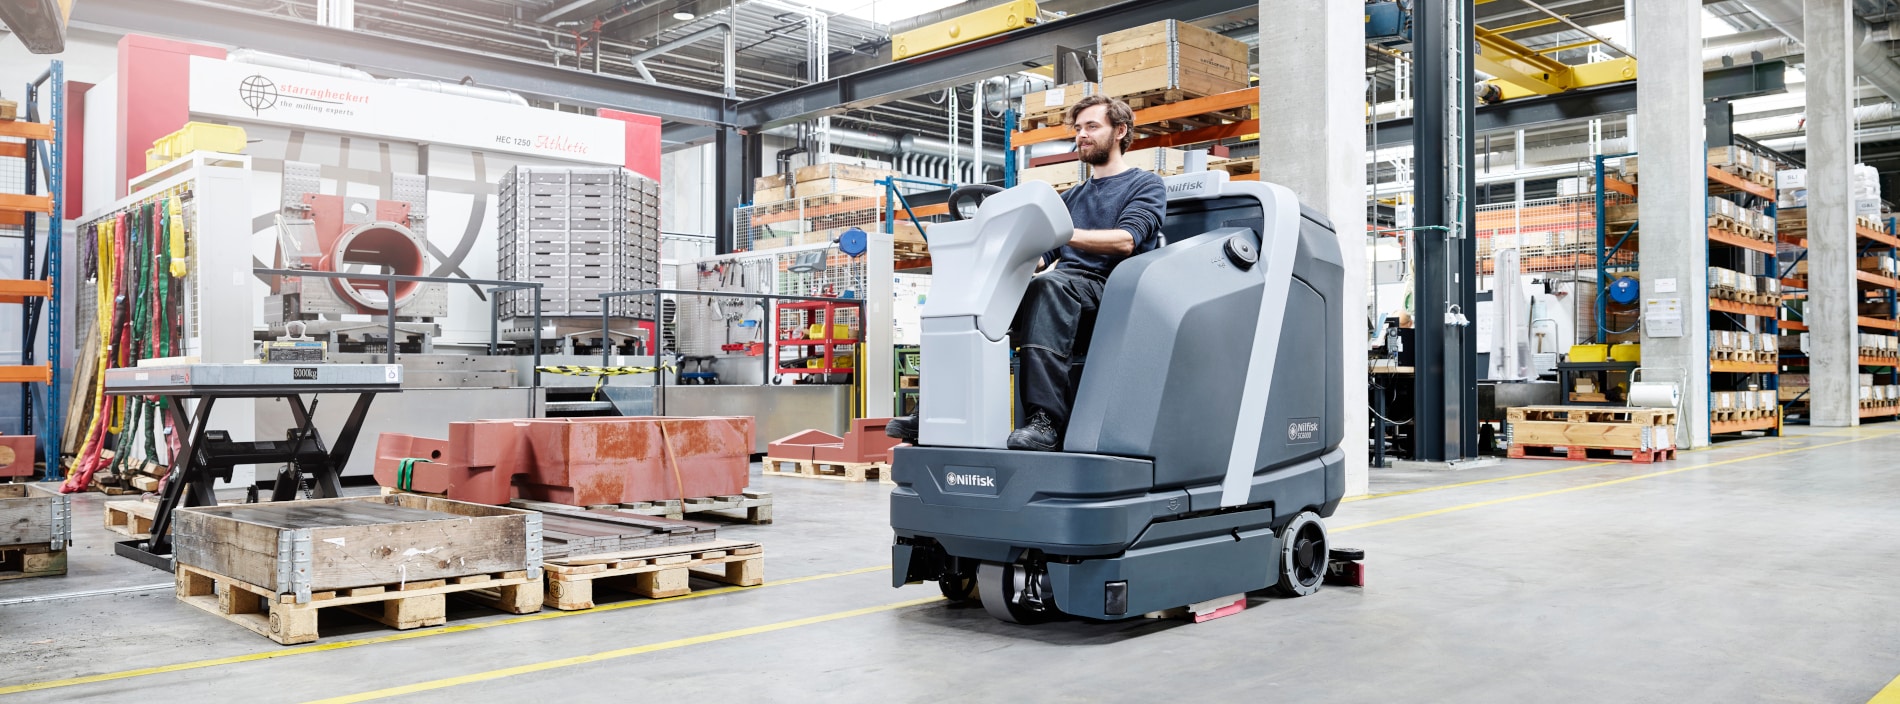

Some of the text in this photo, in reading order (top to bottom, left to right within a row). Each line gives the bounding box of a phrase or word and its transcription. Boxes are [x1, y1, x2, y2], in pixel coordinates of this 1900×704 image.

[280, 83, 370, 104] starragheckert
[280, 100, 355, 117] the milling experts
[495, 135, 590, 154] HEC 1250 Athletic
[1166, 180, 1204, 193] Nilfisk
[294, 368, 317, 379] 3000kg
[1297, 422, 1318, 431] Nilfisk
[956, 474, 995, 487] Nilfisk
